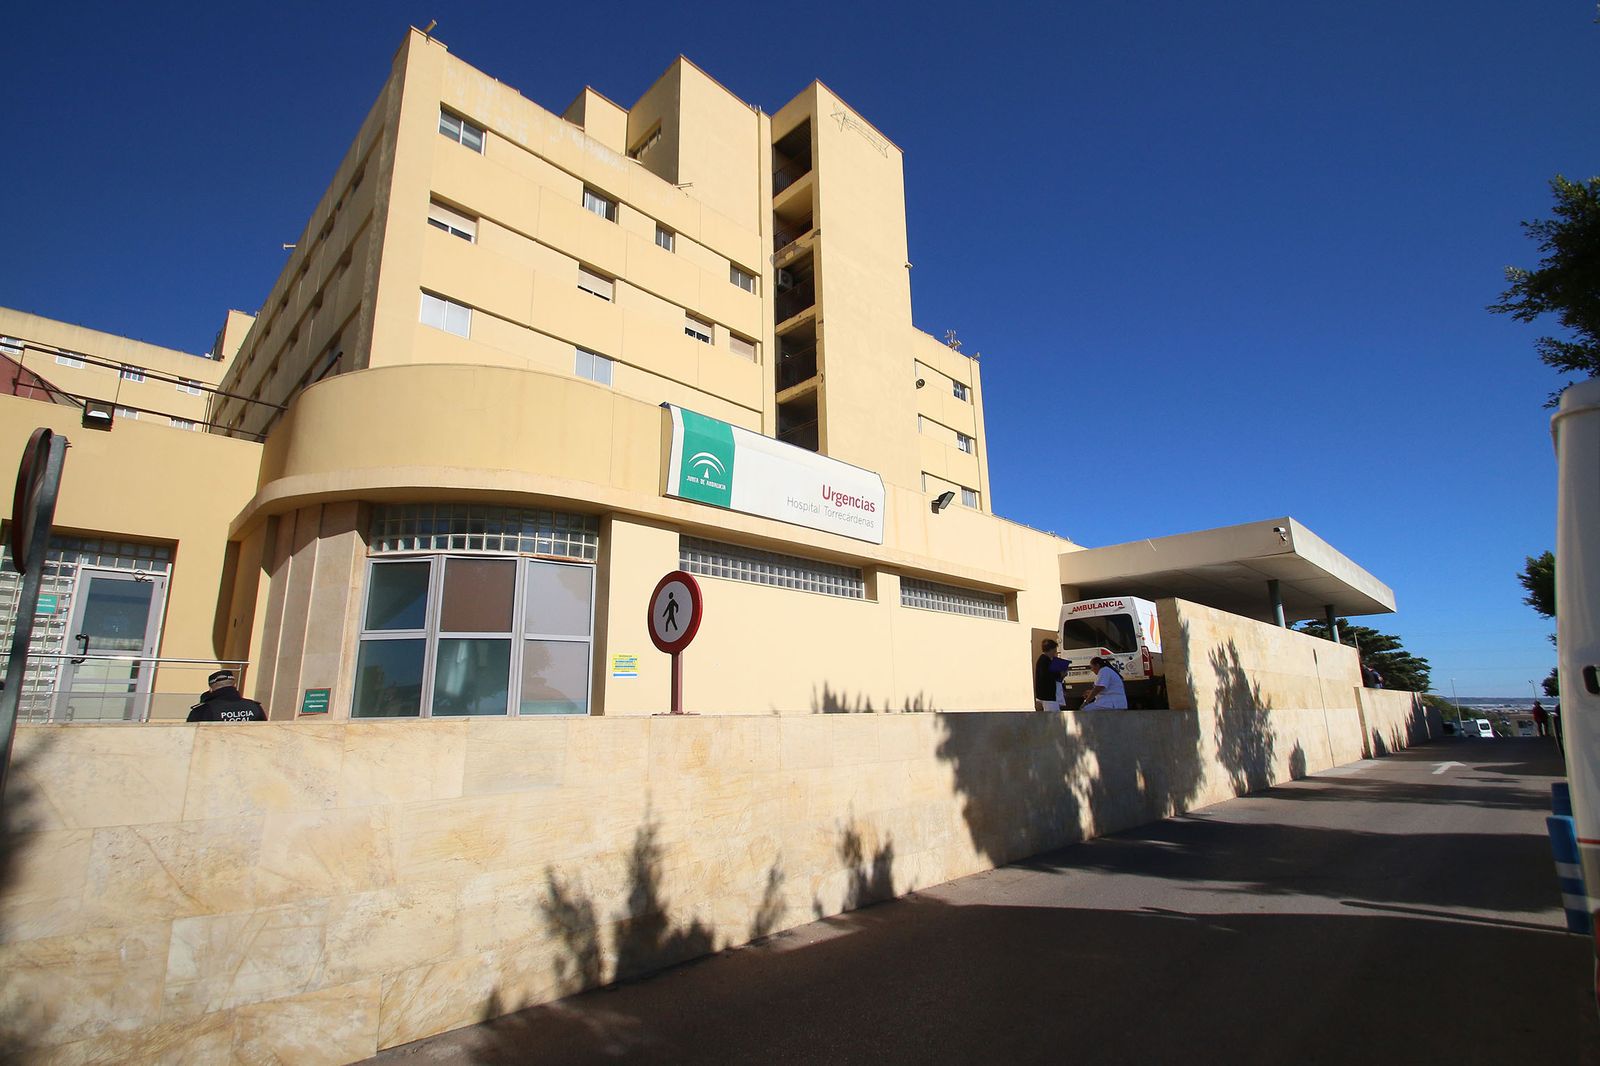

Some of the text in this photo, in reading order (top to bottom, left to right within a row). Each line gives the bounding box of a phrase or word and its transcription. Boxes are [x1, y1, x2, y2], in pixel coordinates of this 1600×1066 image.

[822, 484, 876, 513] Urgencias
[787, 496, 875, 529] Hospital Torrecárdenas
[1071, 600, 1124, 613] AMBULANCIA
[221, 710, 254, 719] POLICIA
